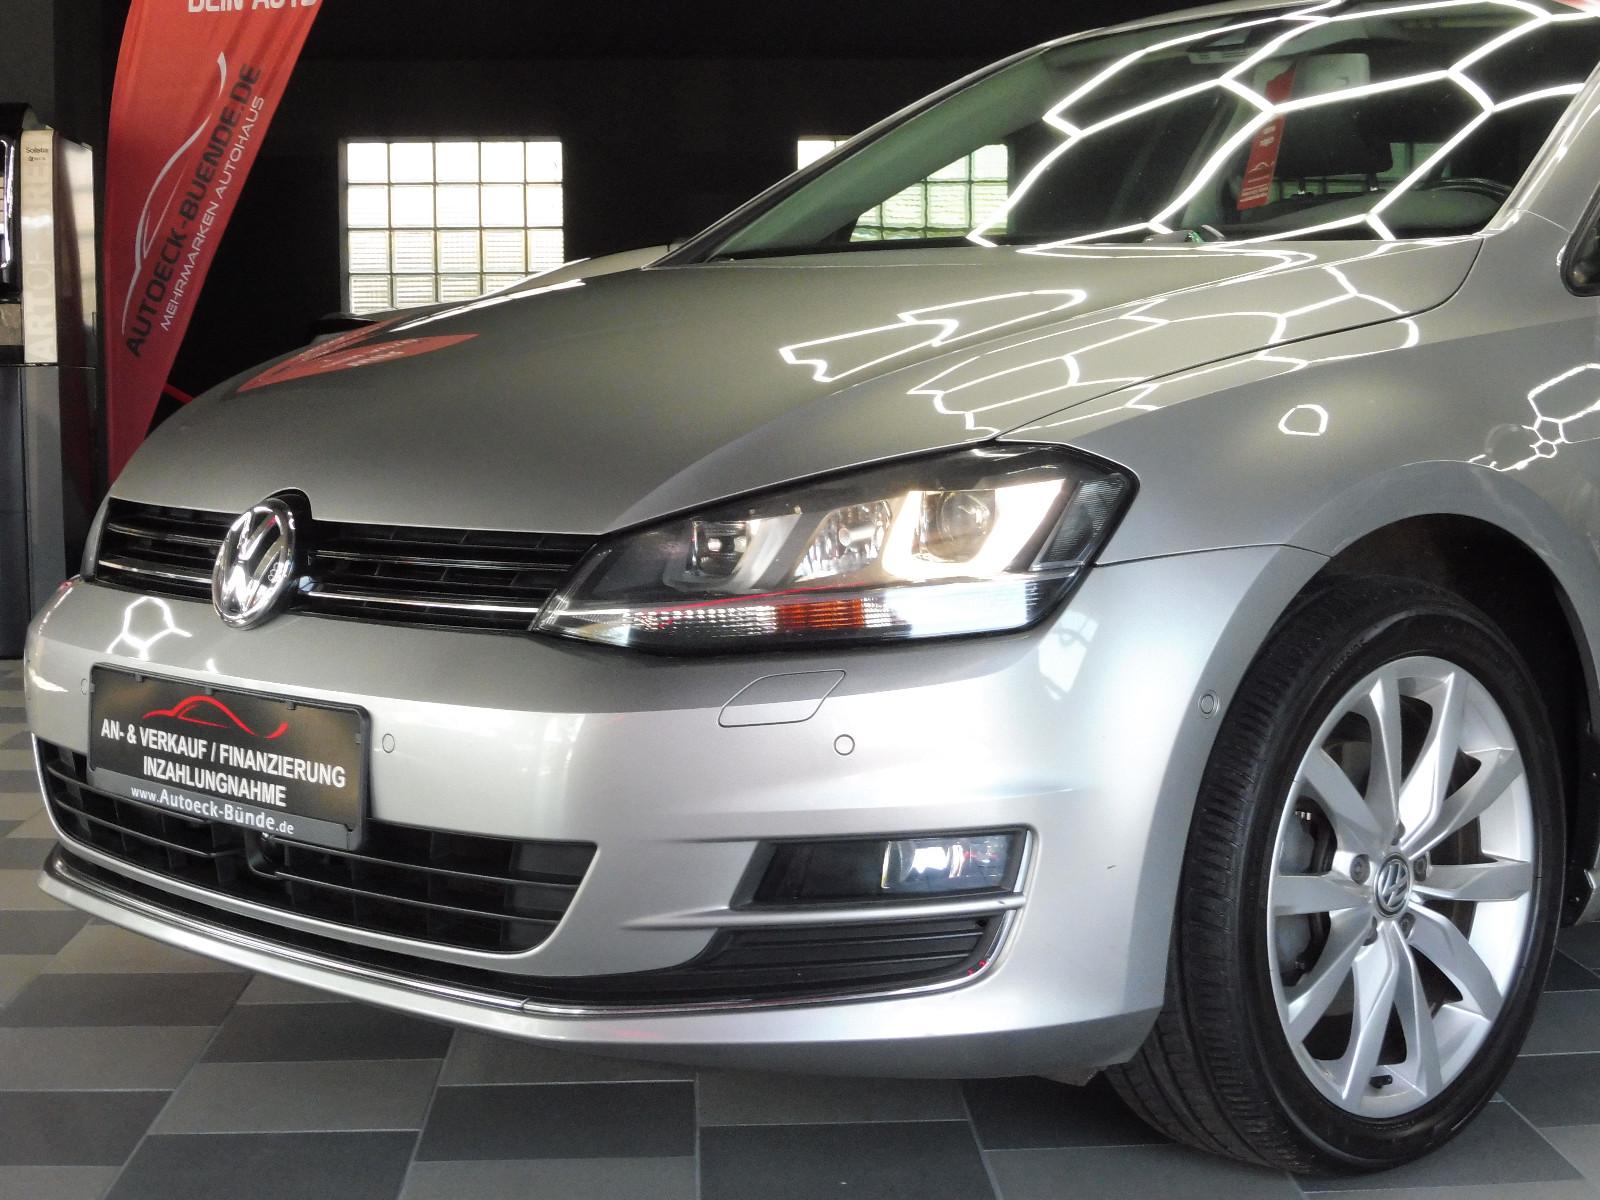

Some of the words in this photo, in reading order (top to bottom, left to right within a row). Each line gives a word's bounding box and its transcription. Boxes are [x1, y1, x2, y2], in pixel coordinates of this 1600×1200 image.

[126, 63, 261, 358] AUTOECK-BUENDE.DE
[160, 201, 219, 332] MEHRMARKEN
[215, 96, 265, 199] AUTOHAUS
[101, 718, 125, 741] AN-
[126, 723, 137, 745] &
[139, 726, 208, 760] VERKAUF
[210, 741, 217, 762] /
[219, 743, 346, 788] FINANZIERUNG
[143, 755, 287, 807] INZAHLUNGNAHME
[130, 786, 294, 834] www.Autoeck-Bünde.de
